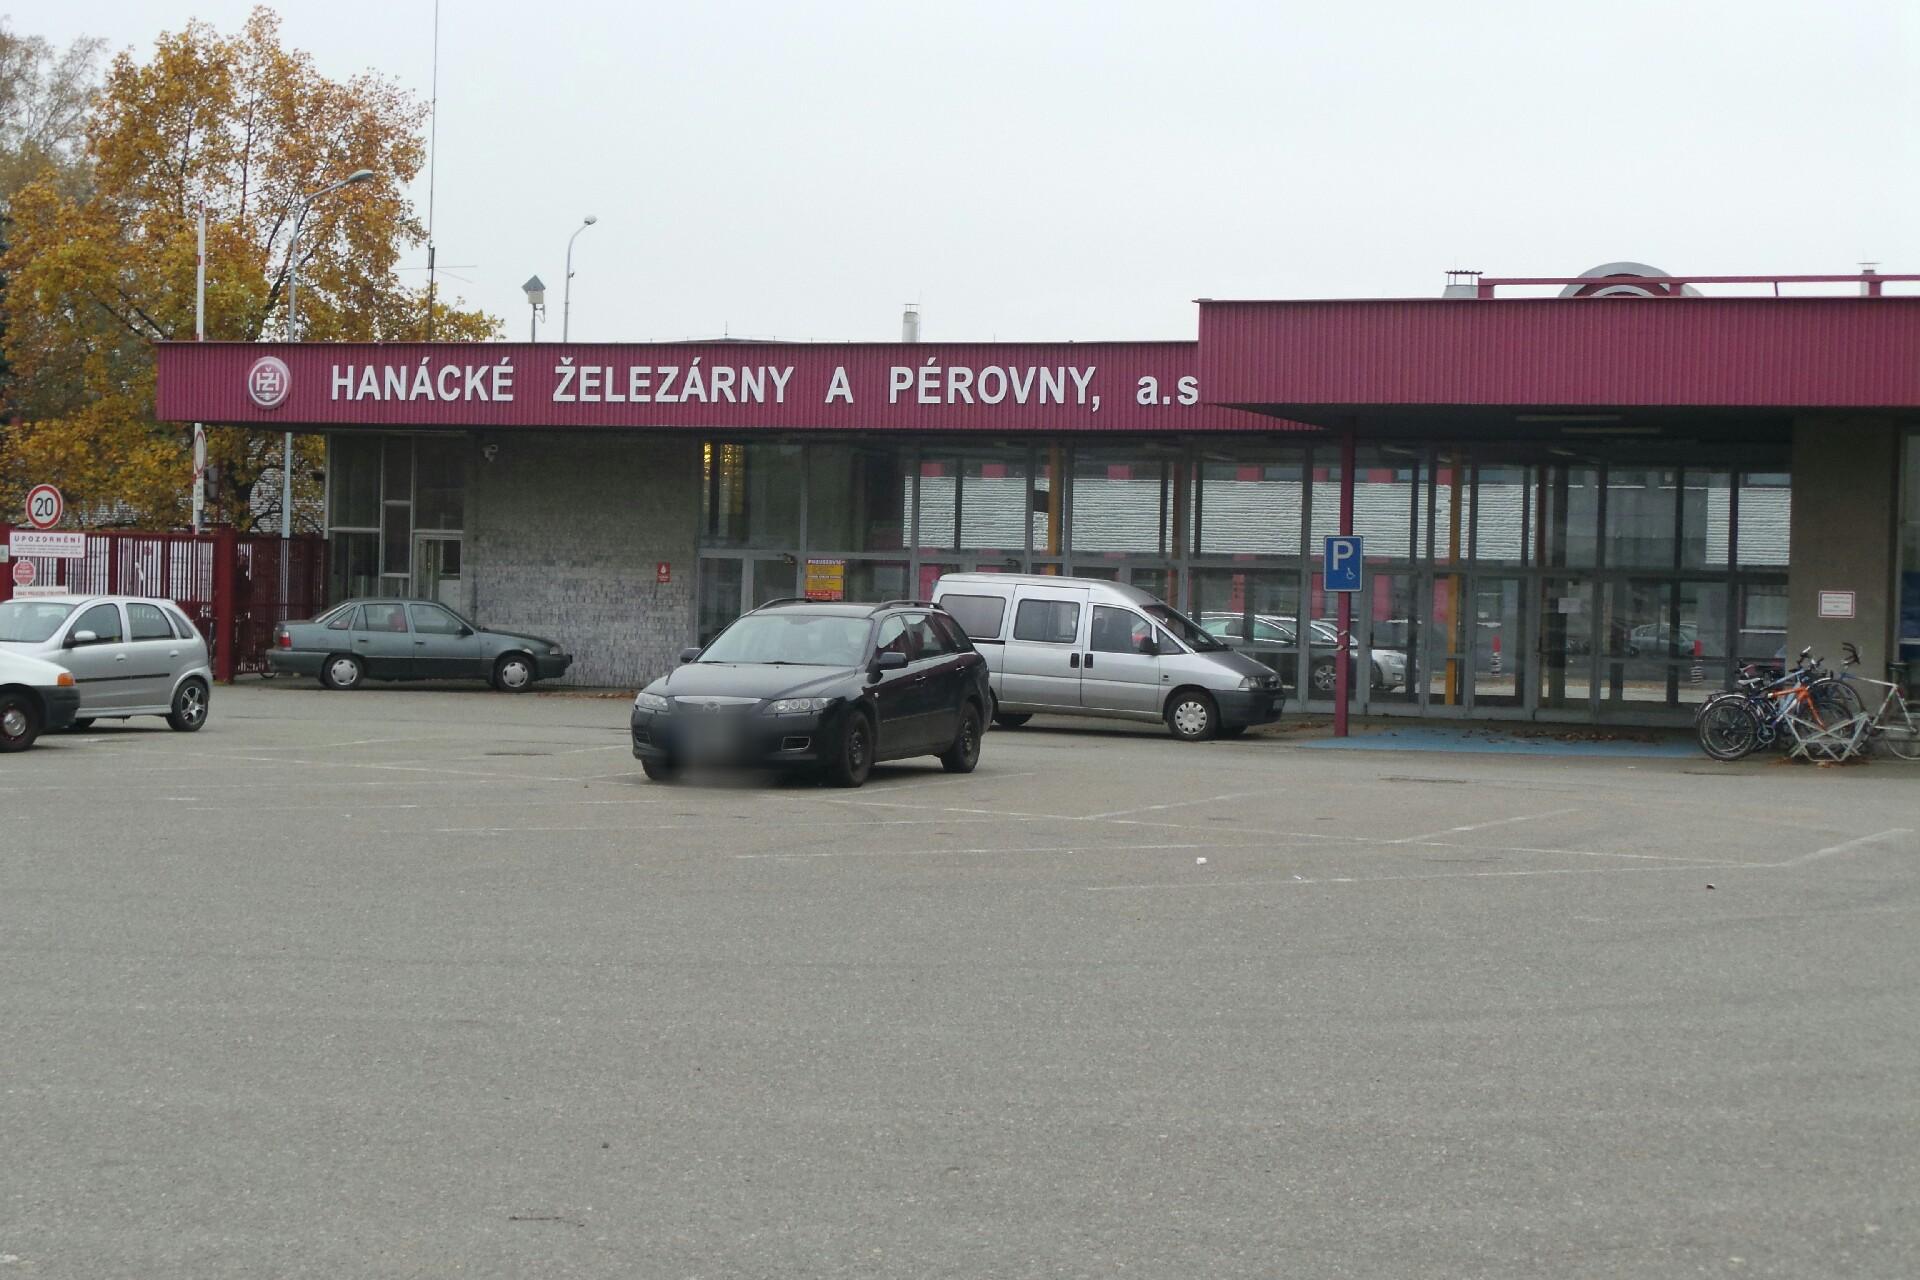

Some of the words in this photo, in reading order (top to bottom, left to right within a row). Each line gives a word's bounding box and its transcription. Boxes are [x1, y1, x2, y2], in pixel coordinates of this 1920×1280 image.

[331, 356, 514, 402] HANÁCKÉ
[552, 356, 795, 403] ŽELEZÁRNY
[824, 366, 854, 403] A
[889, 356, 1100, 412] PÉROVNY,
[1136, 375, 1199, 405] a.s
[35, 497, 54, 517] 20
[14, 534, 81, 545] UPOZORNĚNÍ
[1332, 540, 1354, 571] P
